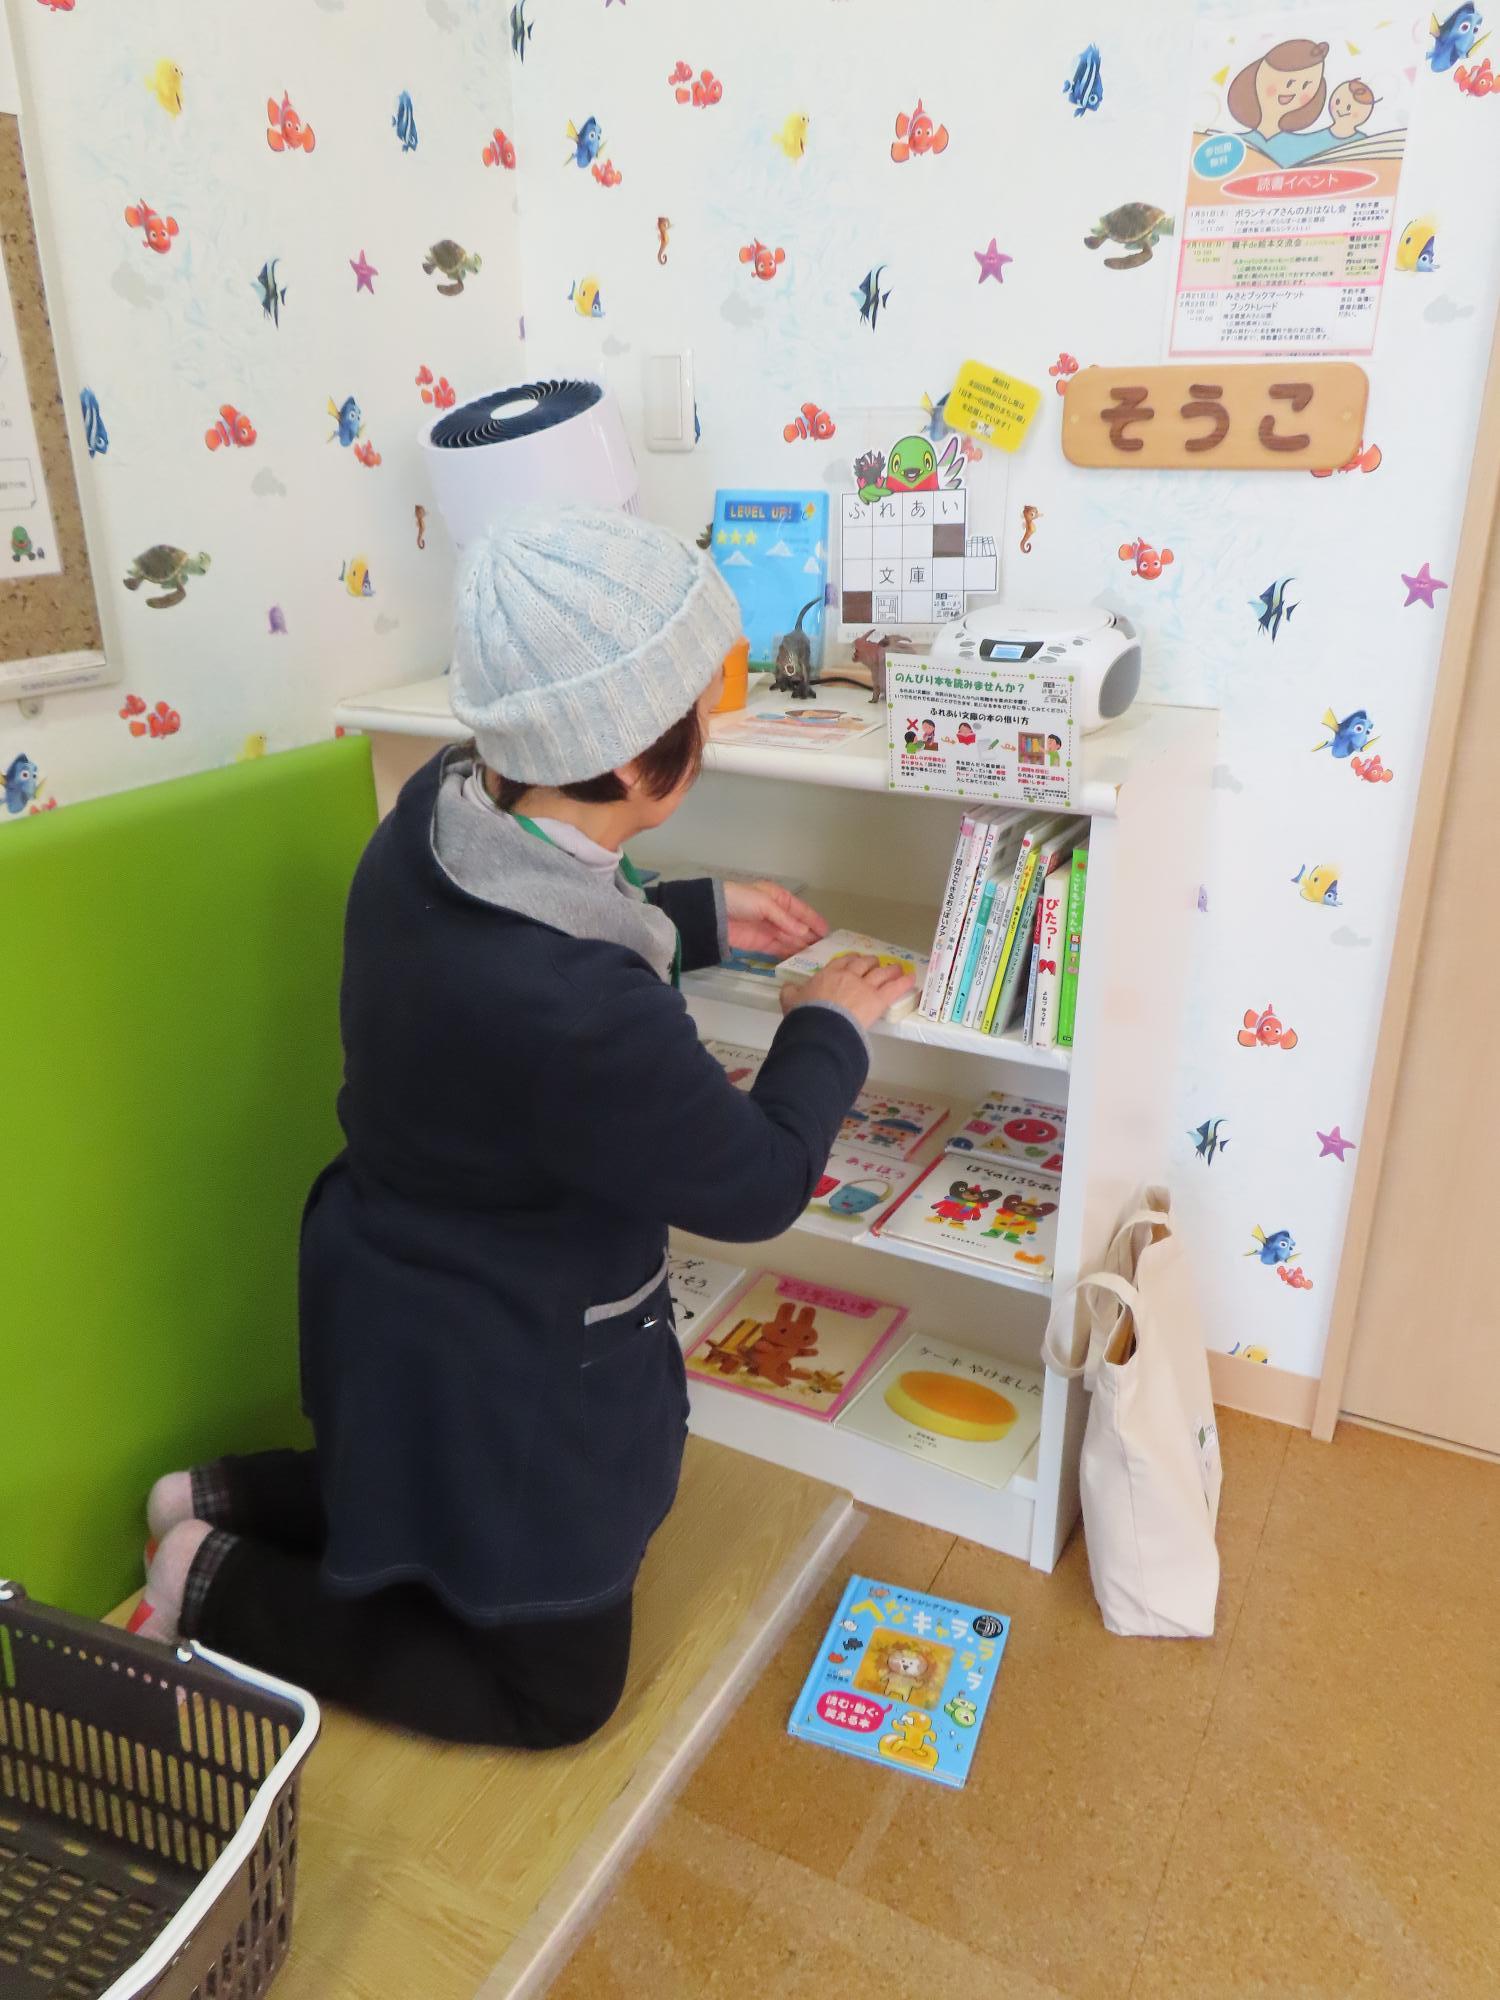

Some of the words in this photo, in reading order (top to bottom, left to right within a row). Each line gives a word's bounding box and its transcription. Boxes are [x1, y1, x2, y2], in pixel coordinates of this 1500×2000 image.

[1257, 173, 1339, 193] 読書イベント
[1235, 204, 1346, 219] ボランティアさんのおはなし会
[1231, 239, 1302, 250] 親子de絵本交流会
[1225, 290, 1305, 301] みさとブックマーケット
[1230, 302, 1279, 312] ブックトレード
[1100, 383, 1315, 452] そうこ
[730, 505, 766, 519] LEVEL
[771, 506, 793, 519] UP!
[849, 500, 959, 520] ふれあい
[879, 565, 925, 585] 文庫
[895, 672, 1025, 693] のんびり本を読みませんか？
[930, 707, 1030, 725] ふれあい文庫の本の借り方
[939, 857, 963, 938] 自分でできるおっぱいケア
[920, 1346, 962, 1367] ケーキ
[969, 1364, 1044, 1397] やけました
